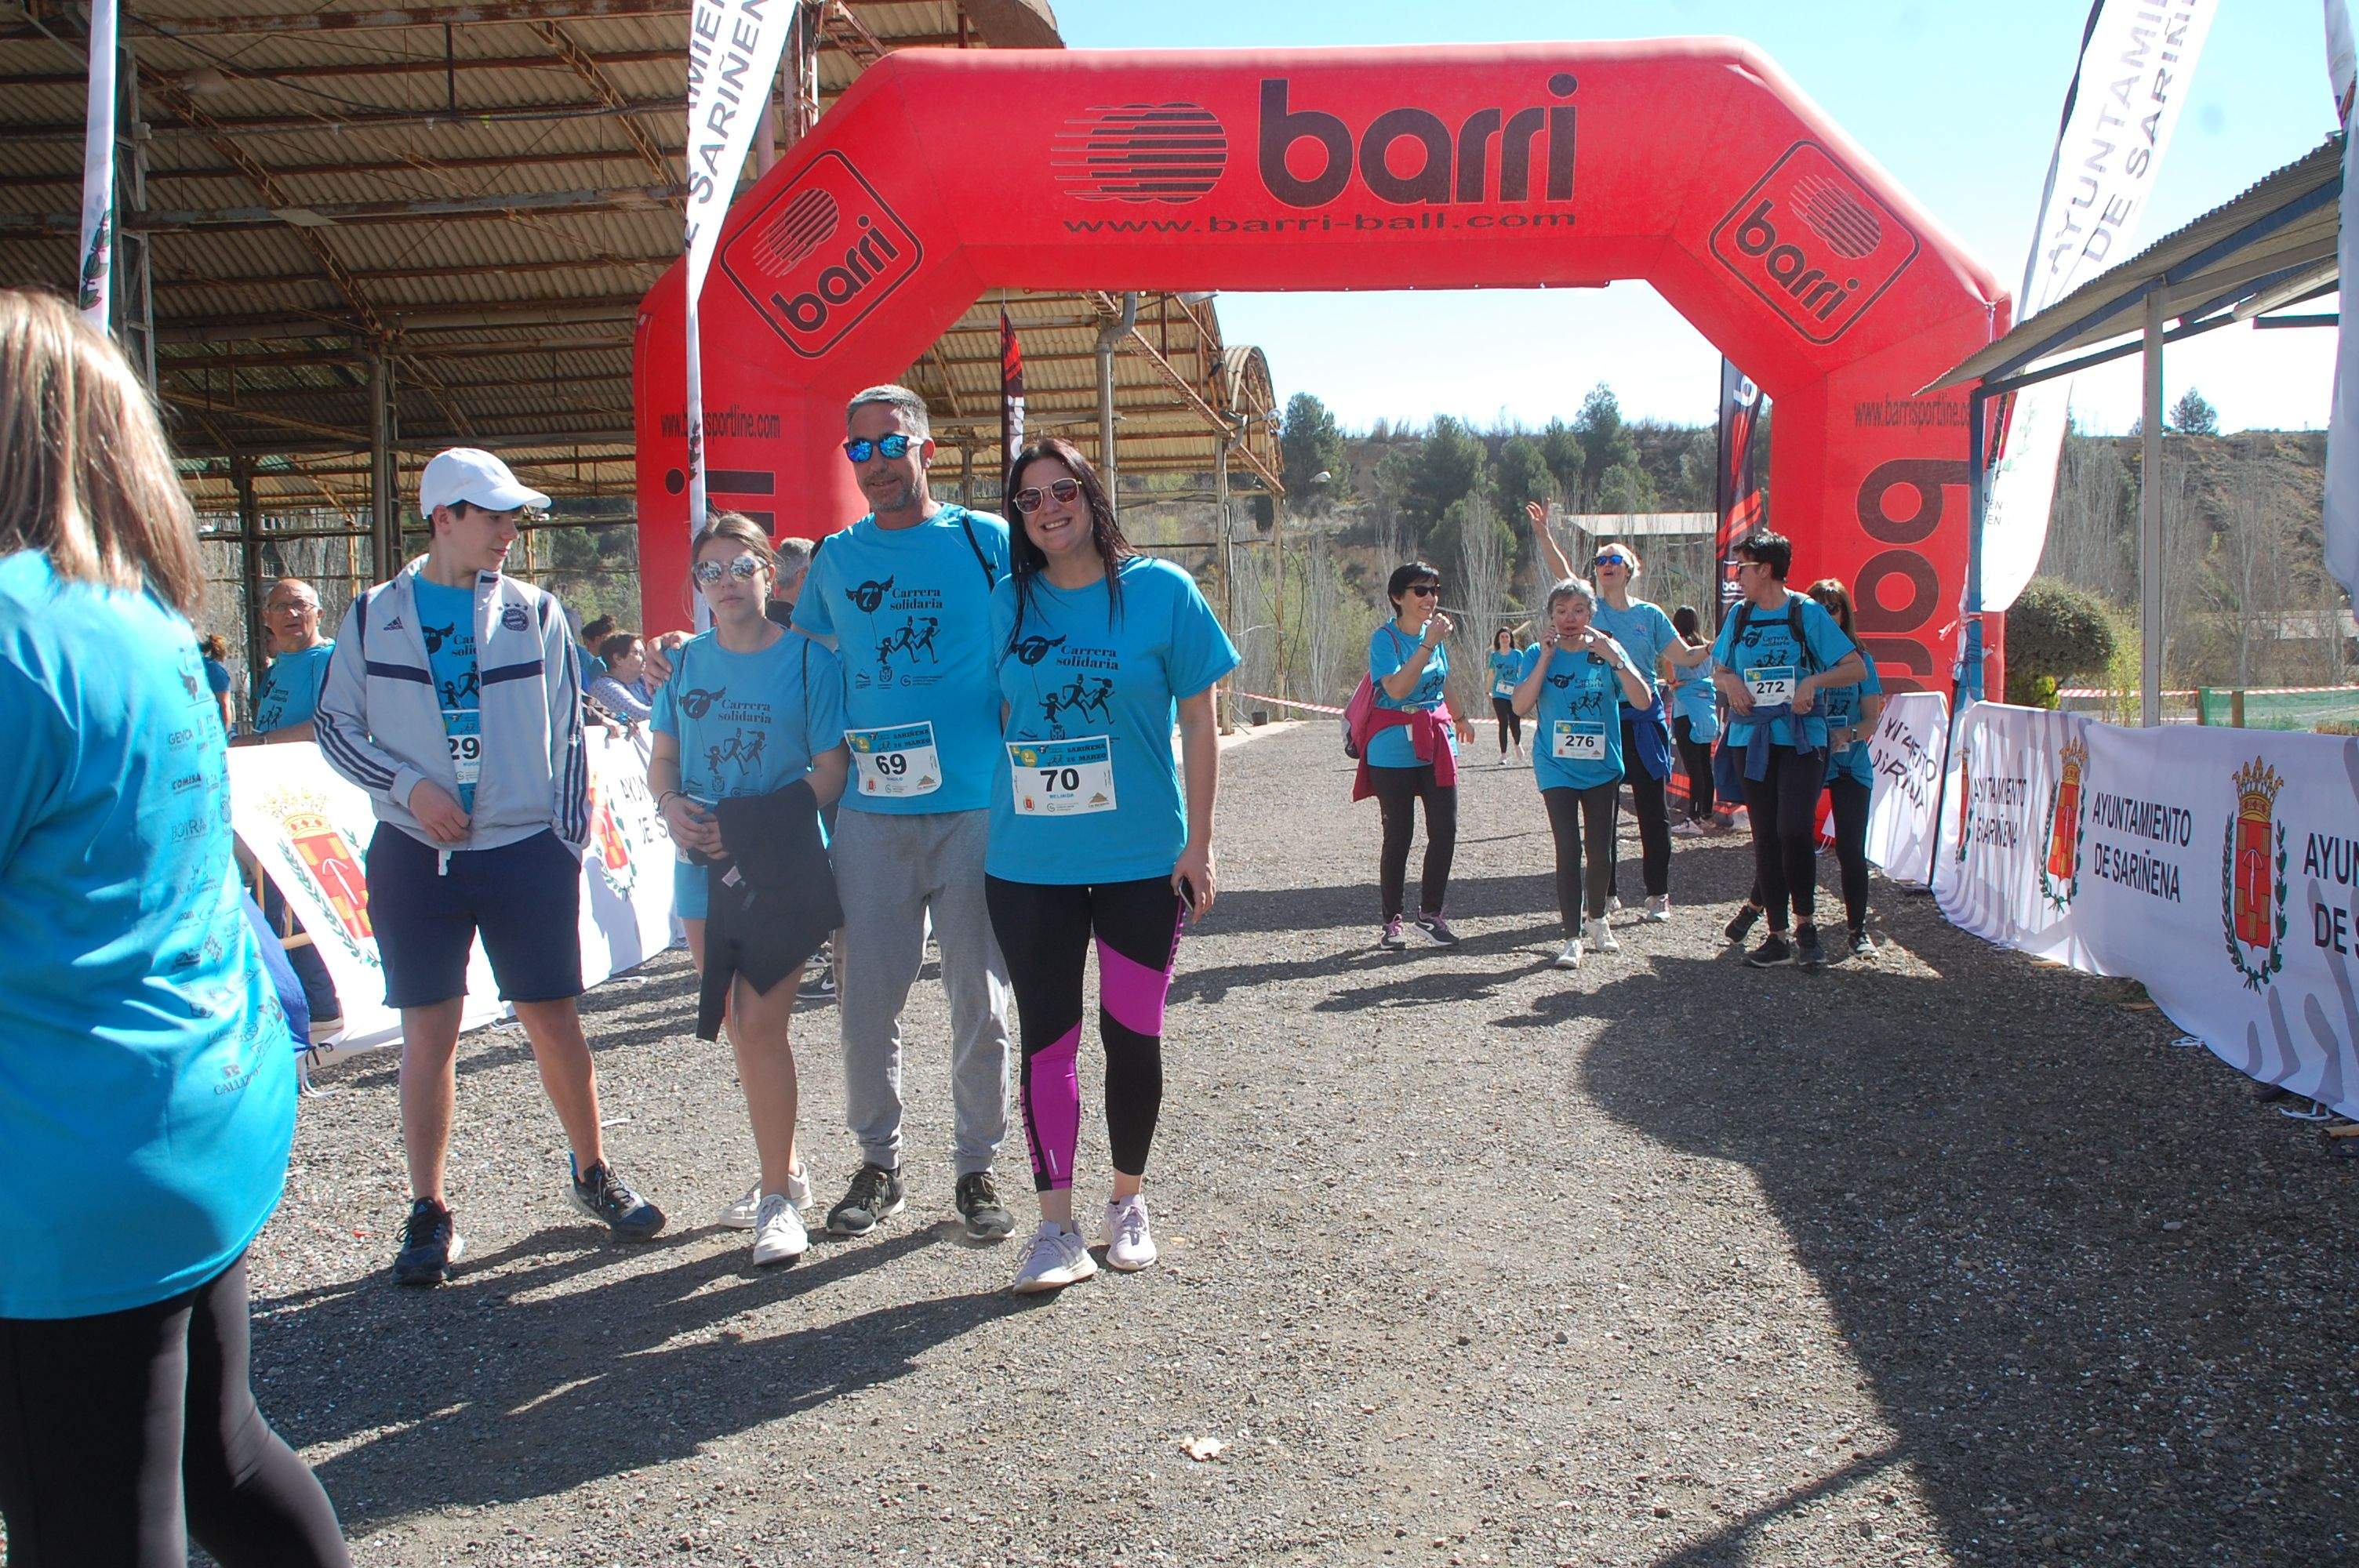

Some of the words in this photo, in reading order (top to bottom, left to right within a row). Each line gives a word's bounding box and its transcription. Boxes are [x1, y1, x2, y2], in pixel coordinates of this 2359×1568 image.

[1258, 73, 1578, 209] barri
[1063, 211, 1576, 233] www.barri-ball.com
[2081, 194, 2134, 263] DE
[1735, 198, 1859, 321] barri
[769, 214, 900, 332] barri
[890, 597, 943, 610] solidaria
[892, 587, 940, 598] Carrera
[1061, 645, 1117, 658] Carrera
[1056, 656, 1118, 670] solidaria
[1756, 681, 1785, 694] 272
[722, 699, 771, 712] Carrera
[718, 710, 772, 724] solidaria
[1565, 735, 1594, 747] 276
[875, 753, 907, 775] 69
[1040, 768, 1080, 792] 70
[2092, 792, 2192, 848] AYUNTAMIENTO
[2095, 843, 2109, 879] DE
[2113, 848, 2180, 903] SARIÑENA
[2315, 902, 2347, 955] DE
